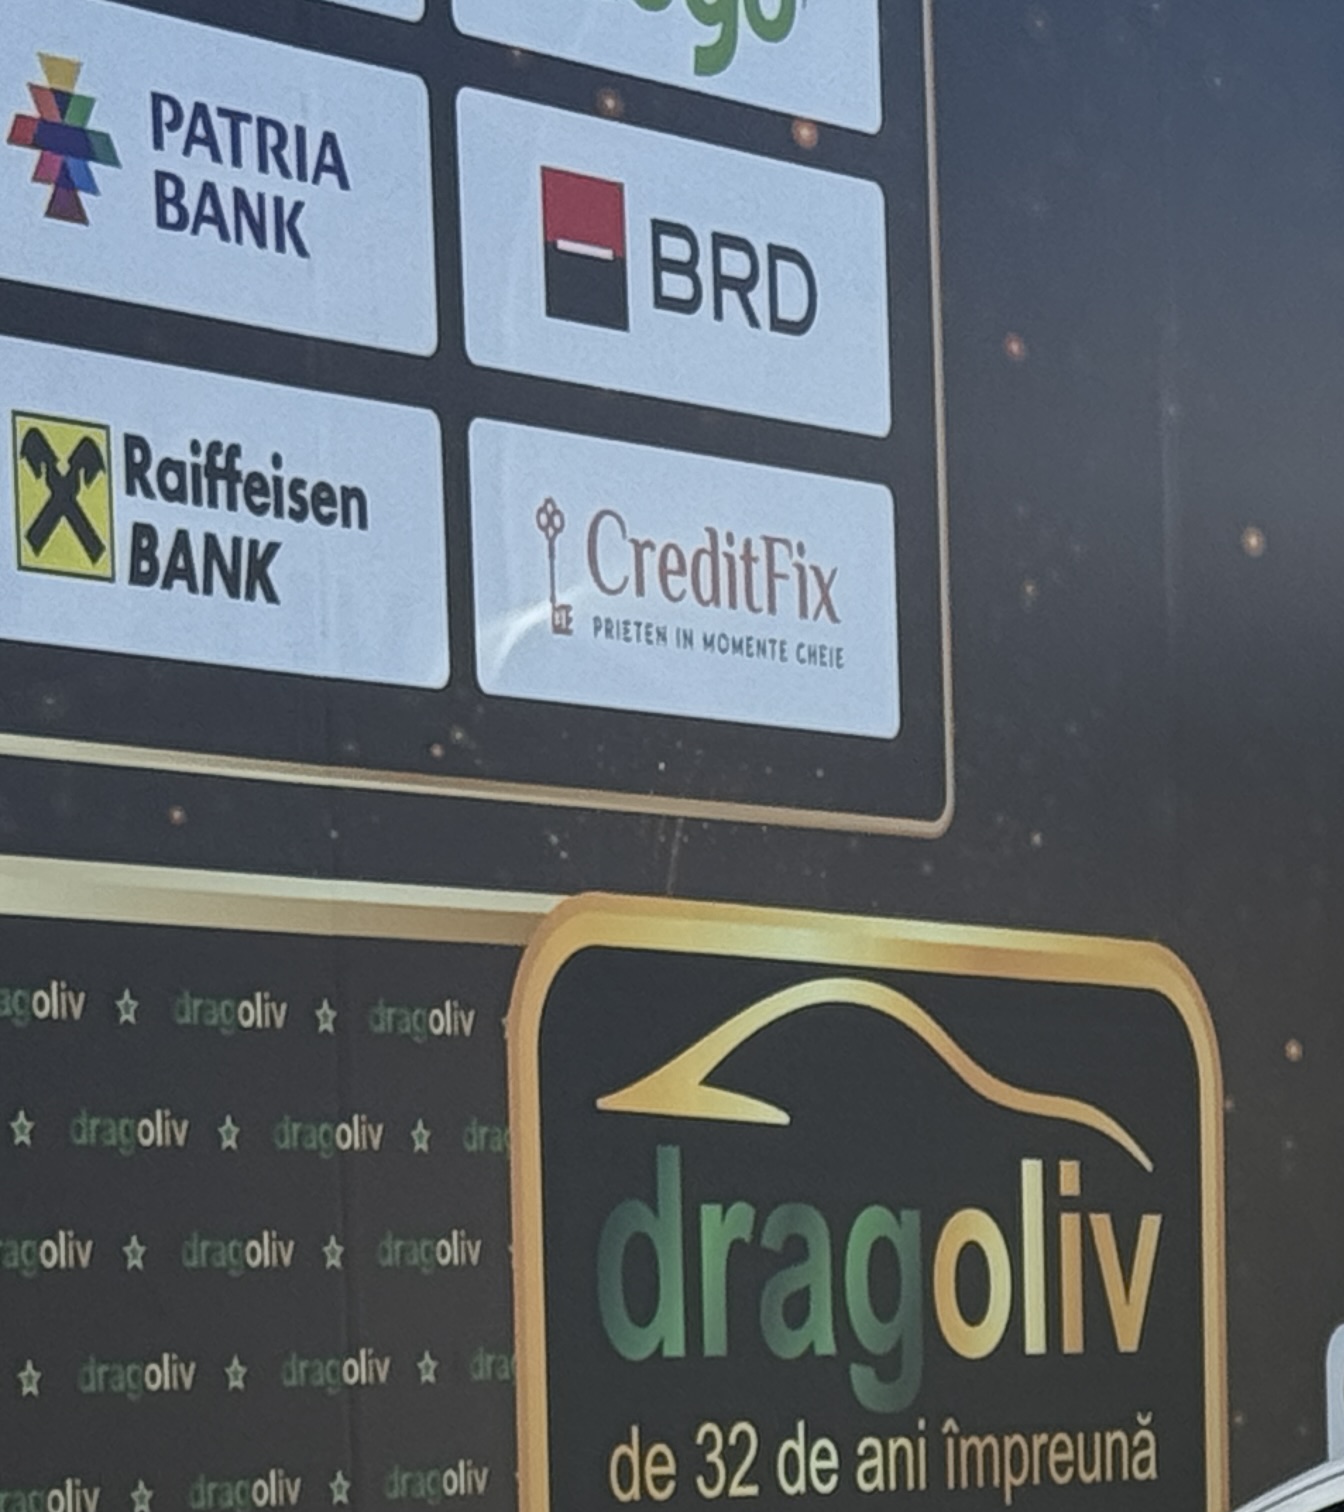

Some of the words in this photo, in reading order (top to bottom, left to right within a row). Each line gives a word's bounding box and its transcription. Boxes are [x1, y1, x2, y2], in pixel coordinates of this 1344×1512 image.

[150, 90, 351, 192] PATRIA
[154, 168, 310, 259] BANK
[650, 217, 818, 337] BRD
[123, 431, 369, 532] Raiffeisen
[127, 520, 283, 606] BANK
[586, 508, 842, 625] CreditFix
[592, 614, 668, 646] PRIETEN
[675, 626, 694, 651] IN
[703, 632, 788, 663] MOMENTE
[795, 641, 845, 670] CHEIE
[173, 990, 288, 1035] dragoliv
[367, 998, 477, 1044] dragoliv
[69, 1108, 190, 1156] dragoliv
[272, 1113, 385, 1159] dragoliv
[181, 1230, 295, 1277] dragoliv
[376, 1229, 483, 1274] dragoliv
[599, 1144, 1163, 1413] dragoliv
[77, 1352, 197, 1401] dragoliv
[280, 1347, 392, 1395] dragoliv
[385, 1458, 489, 1504] dragoliv
[609, 1425, 677, 1503] de
[695, 1420, 761, 1500] 32
[776, 1418, 841, 1495] de
[856, 1417, 927, 1491] ani
[941, 1412, 1158, 1504] împreună
